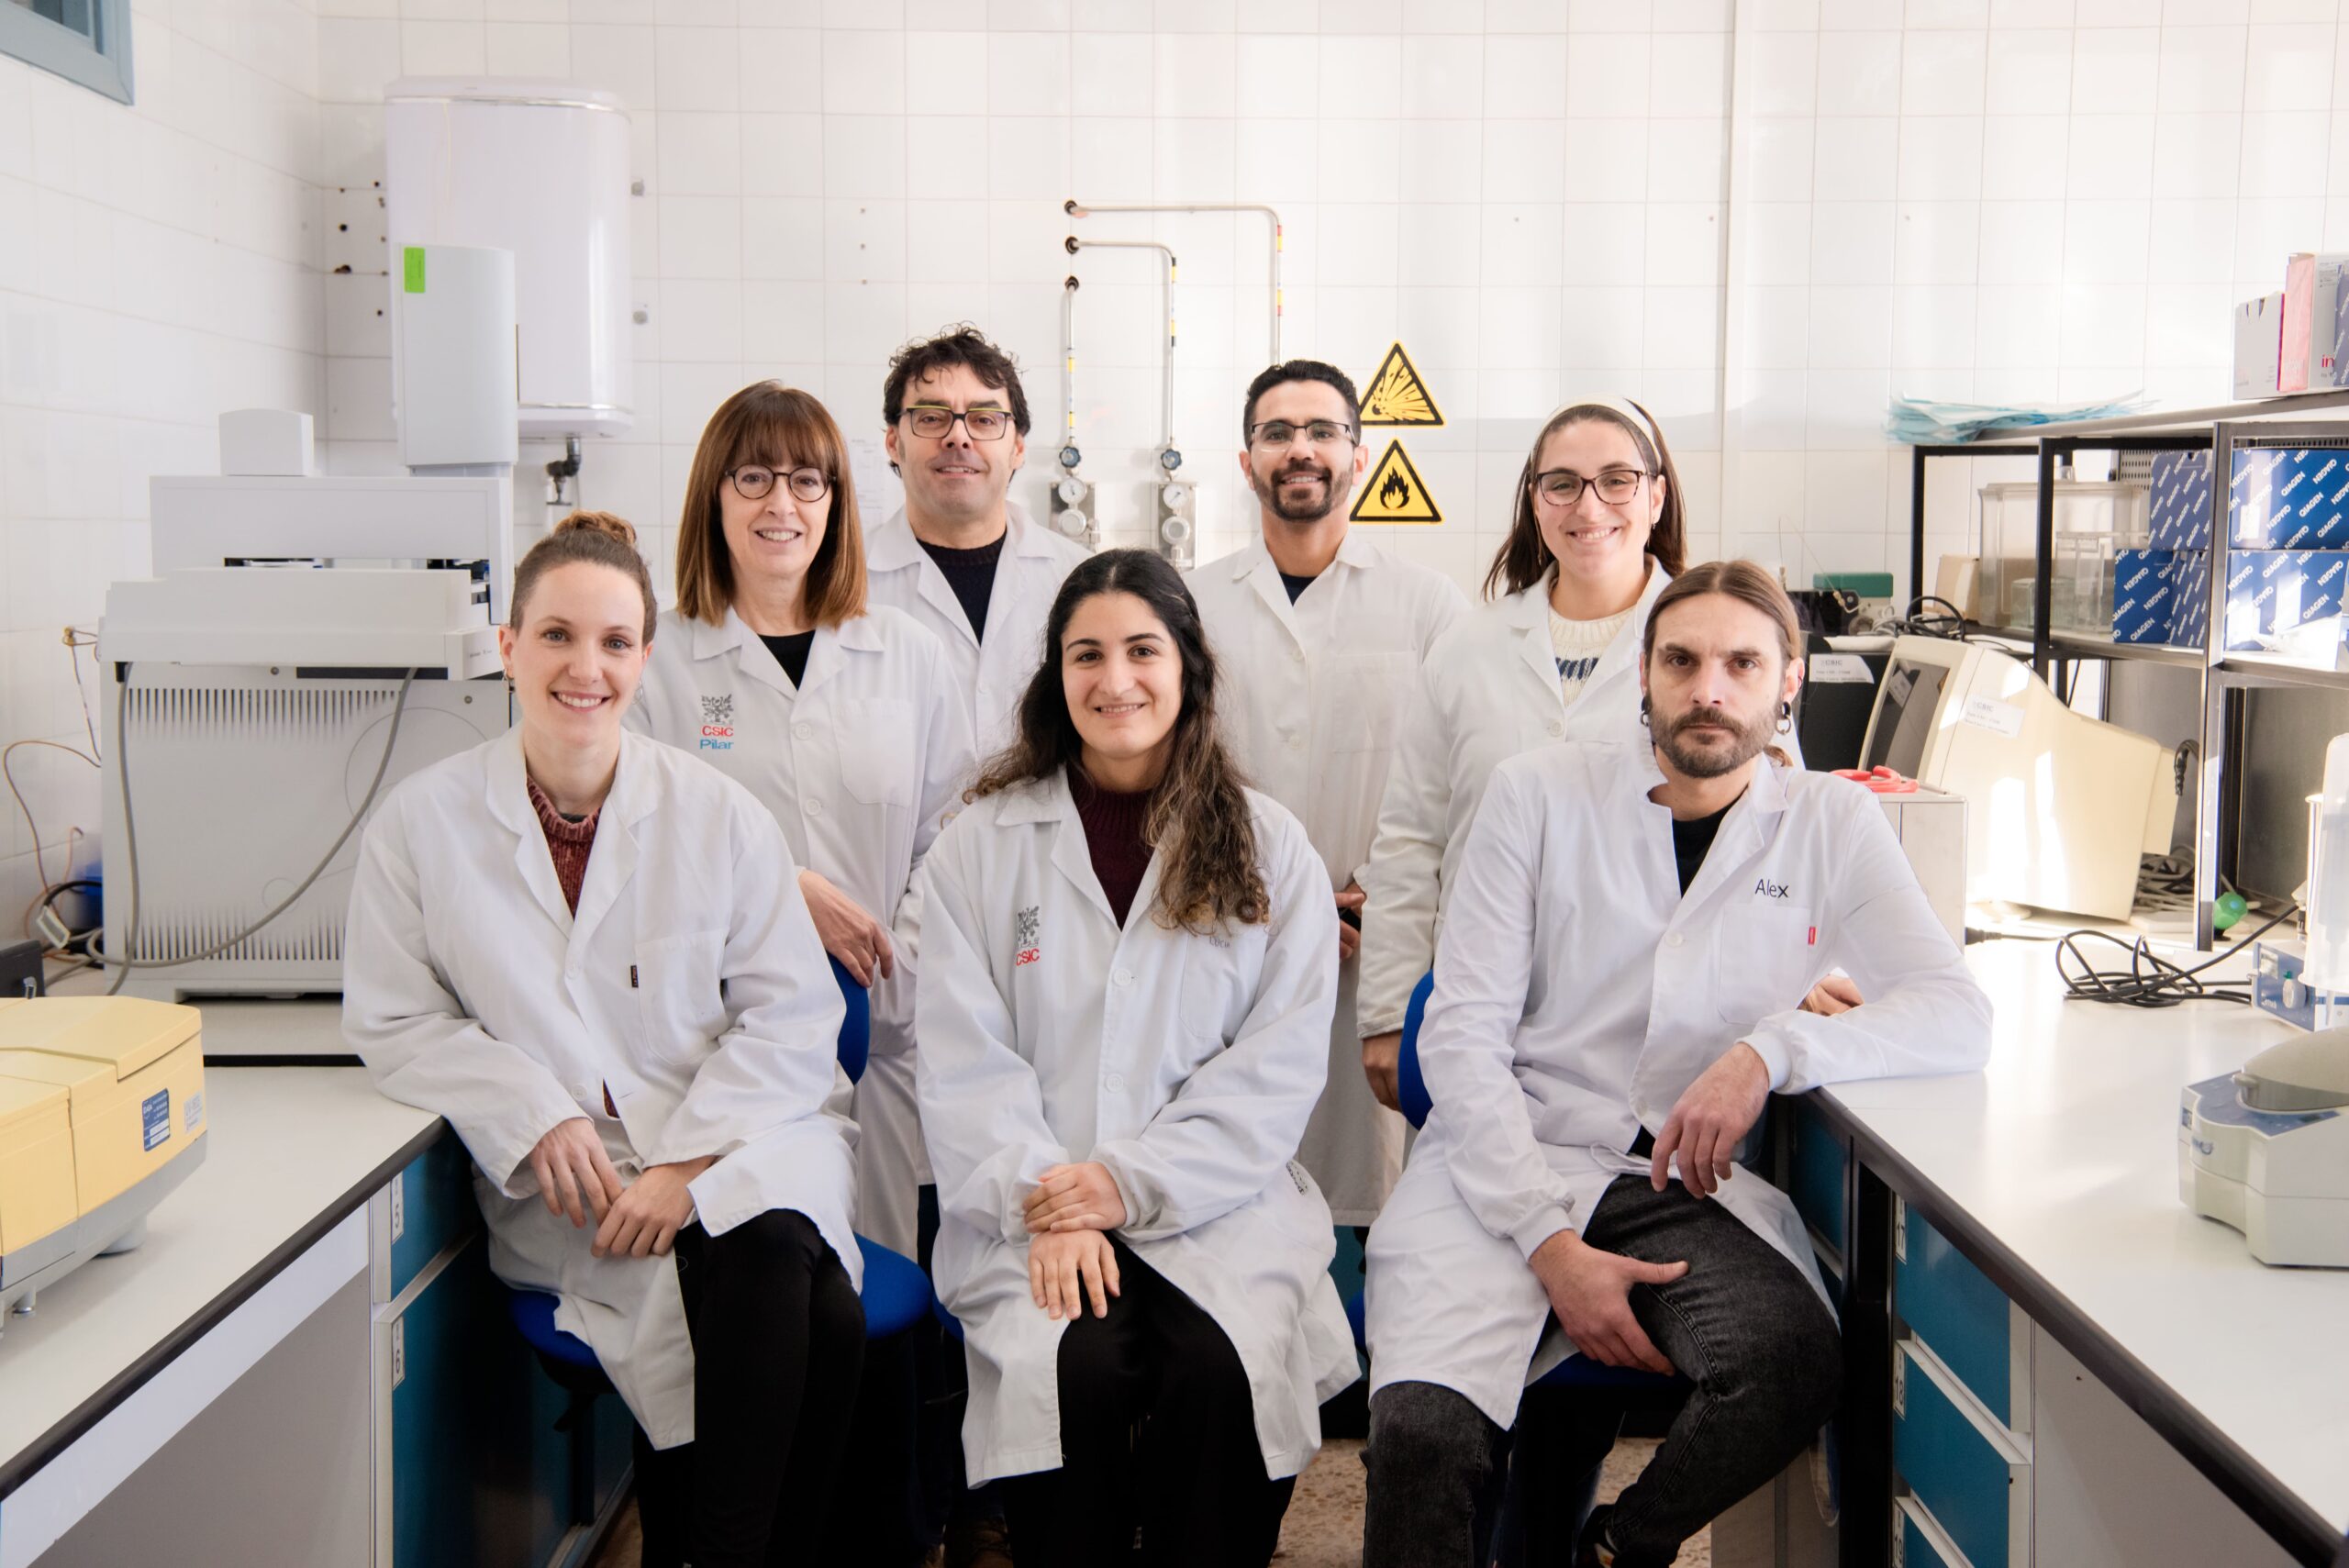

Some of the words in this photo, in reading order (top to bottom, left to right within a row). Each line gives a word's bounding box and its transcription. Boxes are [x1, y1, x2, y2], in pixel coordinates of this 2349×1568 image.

[2281, 471, 2306, 496] QIAGEN
[2312, 459, 2337, 484] QIAGEN
[2299, 492, 2324, 517] QIAGEN
[2266, 505, 2291, 530] QIAGEN
[2317, 512, 2342, 538] QIAGEN
[2284, 525, 2310, 550] QIAGEN
[2123, 567, 2149, 592] QIAGEN
[2318, 561, 2343, 586] QIAGEN
[2143, 586, 2168, 610] QIAGEN
[2302, 594, 2330, 620] QIAGEN
[2130, 617, 2155, 641] QIAGEN
[702, 725, 734, 737] CSIC
[699, 739, 734, 750] Pilar
[1754, 878, 1789, 898] Alex
[1016, 948, 1041, 966] CSIC
